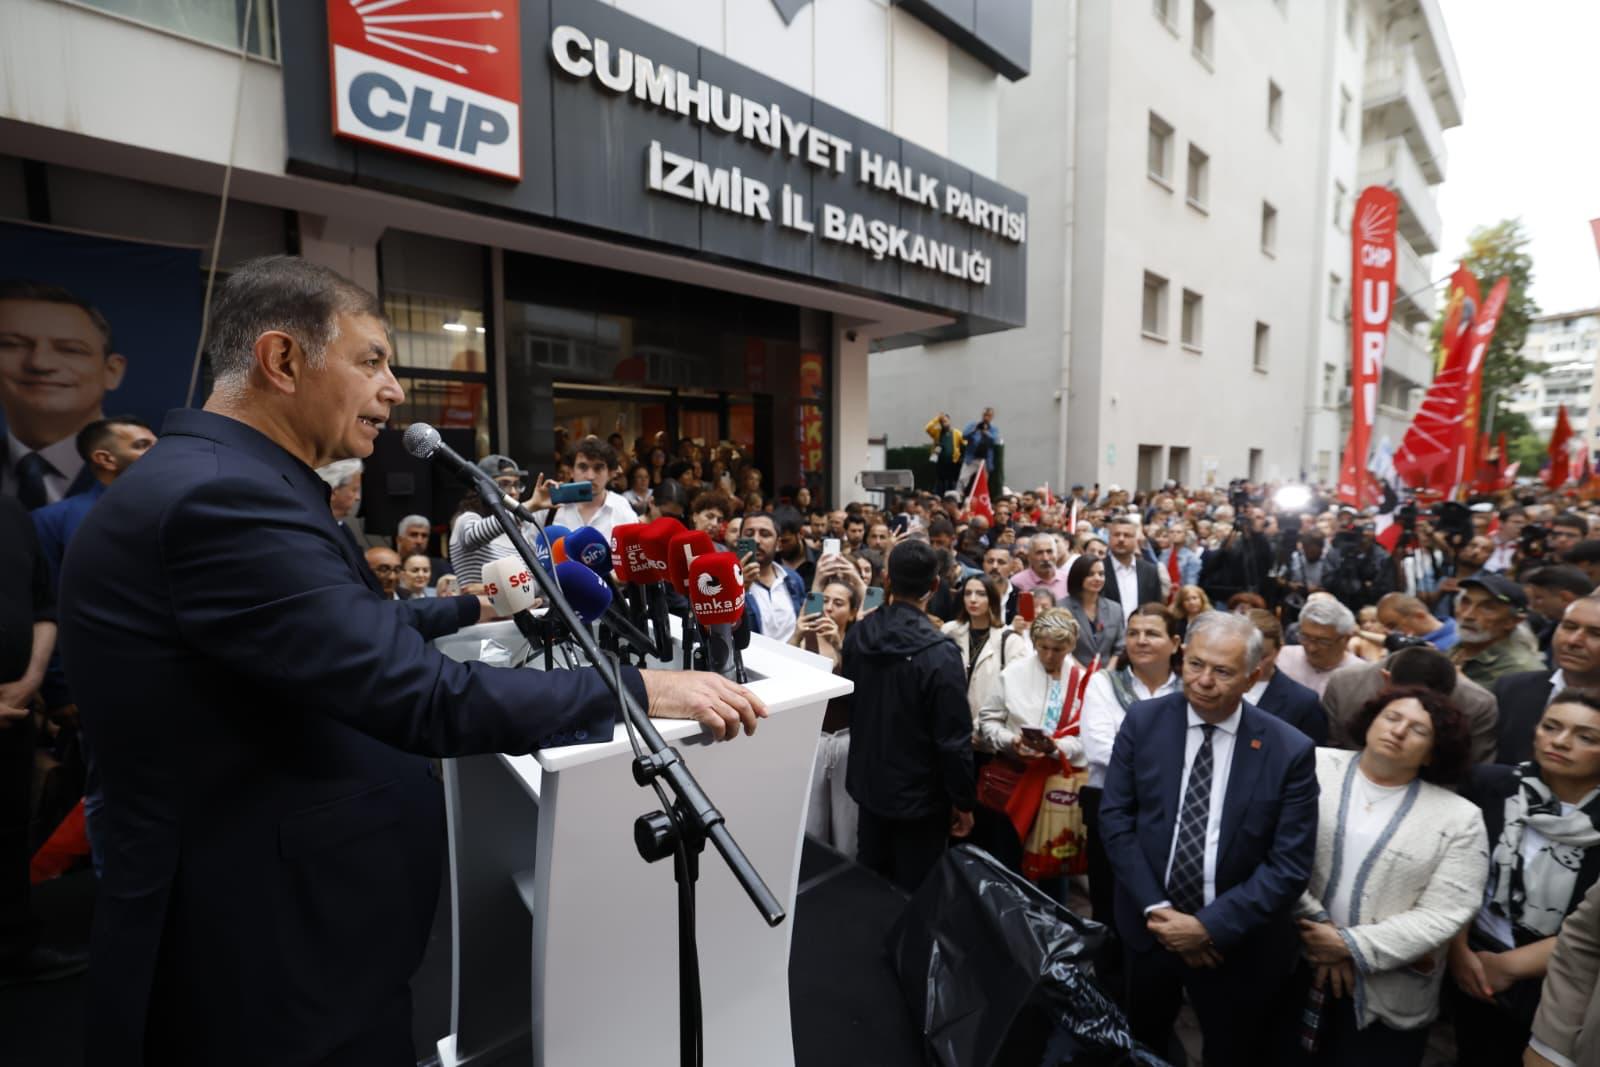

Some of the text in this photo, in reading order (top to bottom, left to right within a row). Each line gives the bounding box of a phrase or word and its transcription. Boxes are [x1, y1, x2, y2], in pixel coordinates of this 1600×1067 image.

[348, 71, 510, 155] CHP
[551, 25, 1026, 243] CUMHURİYET HALK PARTİSİ
[649, 140, 992, 285] İZMİR İL BAŞKANLIĞI
[1361, 244, 1392, 268] CHP
[695, 598, 733, 611] anka
